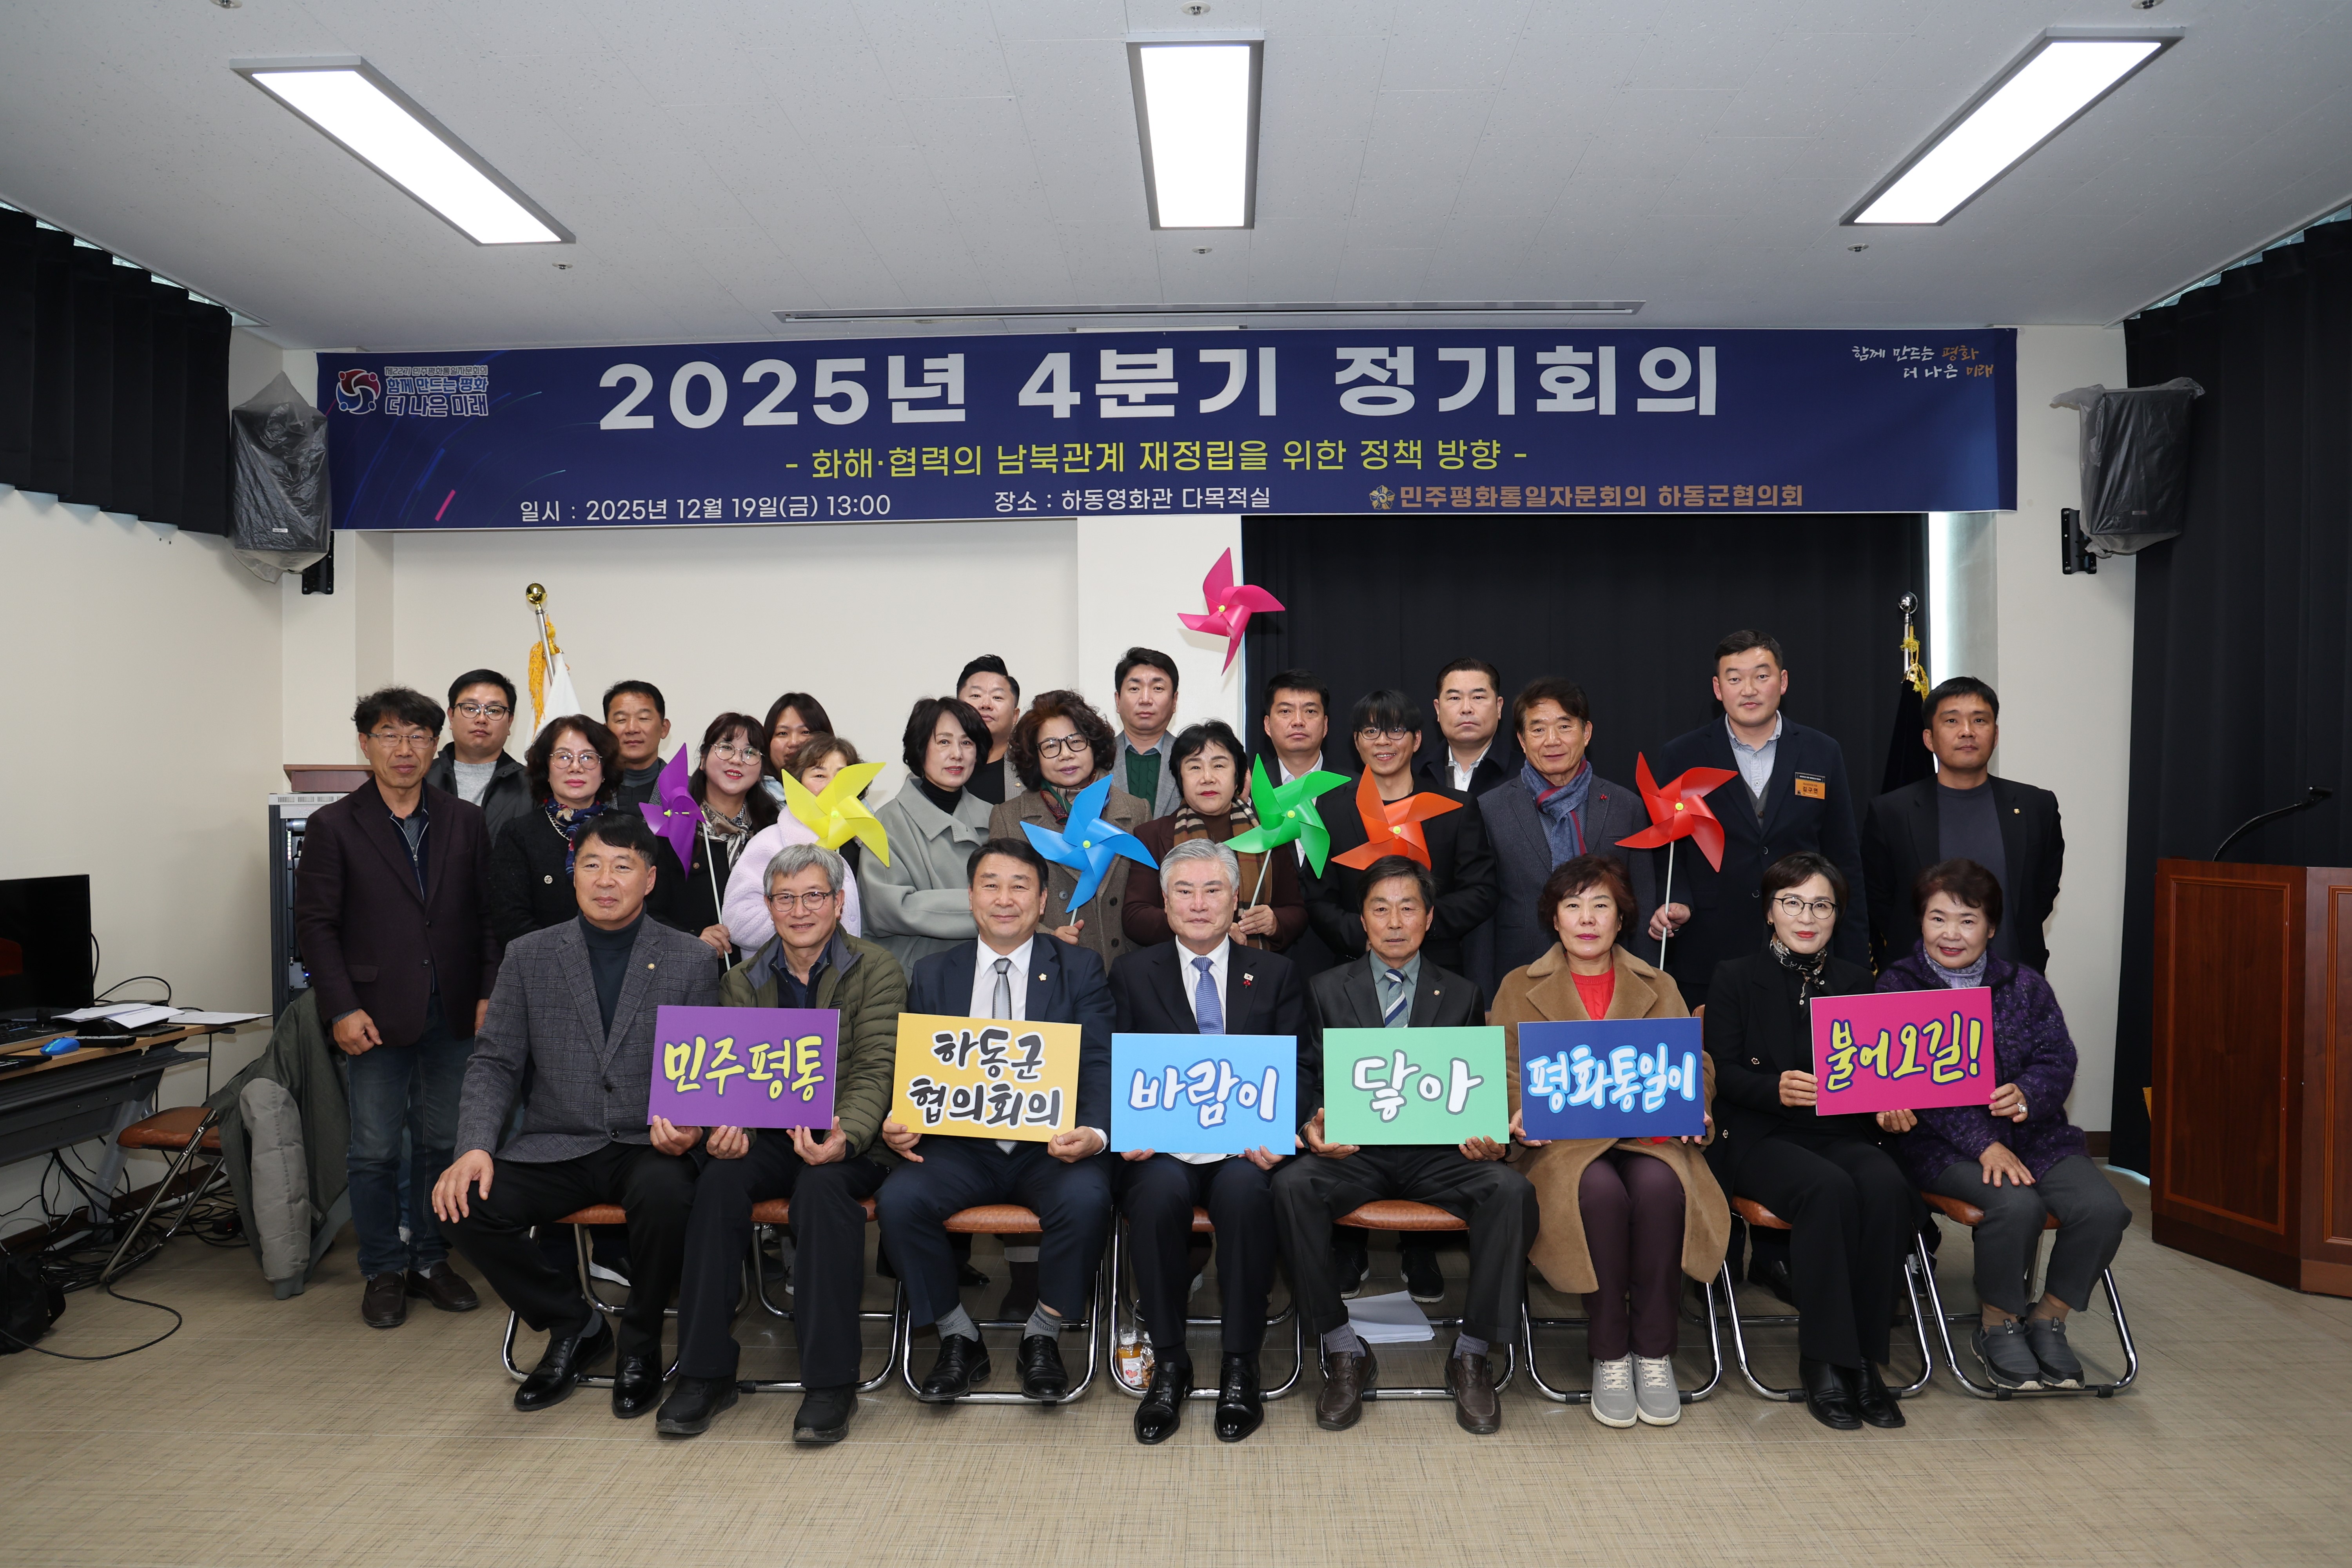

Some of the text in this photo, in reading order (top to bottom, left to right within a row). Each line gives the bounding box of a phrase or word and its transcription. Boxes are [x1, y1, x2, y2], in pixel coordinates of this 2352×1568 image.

[385, 365, 488, 376] 제22기 민주평화통일자문회의
[1852, 345, 1979, 362] 함께 만드는 평화
[1904, 364, 1994, 379] 더 나은 미래
[386, 376, 488, 394] 함께 만드는 평화
[599, 346, 1717, 430] 2025년 4분기 정기회의
[385, 393, 488, 417] 더 나은 미래
[812, 446, 981, 479] 화해·협력의
[998, 443, 1124, 474] 남북관계
[1140, 441, 1268, 471] 재정립을
[1283, 441, 1347, 470] 위한
[1361, 440, 1422, 470] 정책
[1439, 440, 1501, 470] 방향
[521, 501, 560, 522] 일시
[586, 499, 667, 521] 2025년
[677, 498, 722, 519] 12월
[732, 495, 818, 517] 19일(금)
[827, 494, 891, 516] 13:00
[995, 491, 1038, 512] 장소
[1062, 488, 1173, 510] 하동영화관
[1183, 487, 1270, 508] 다목적실
[1401, 485, 1803, 507] 민주평화통일자문회의 하동군협의회
[663, 1035, 825, 1102] 민주평통
[933, 1028, 1043, 1080] 하동군
[1828, 1013, 1982, 1091] 불어오길!
[1129, 1059, 1278, 1128] 바람이
[1353, 1050, 1483, 1122] 닿아
[1528, 1045, 1695, 1112] 평화통일이
[909, 1077, 1060, 1126] 협의회의
